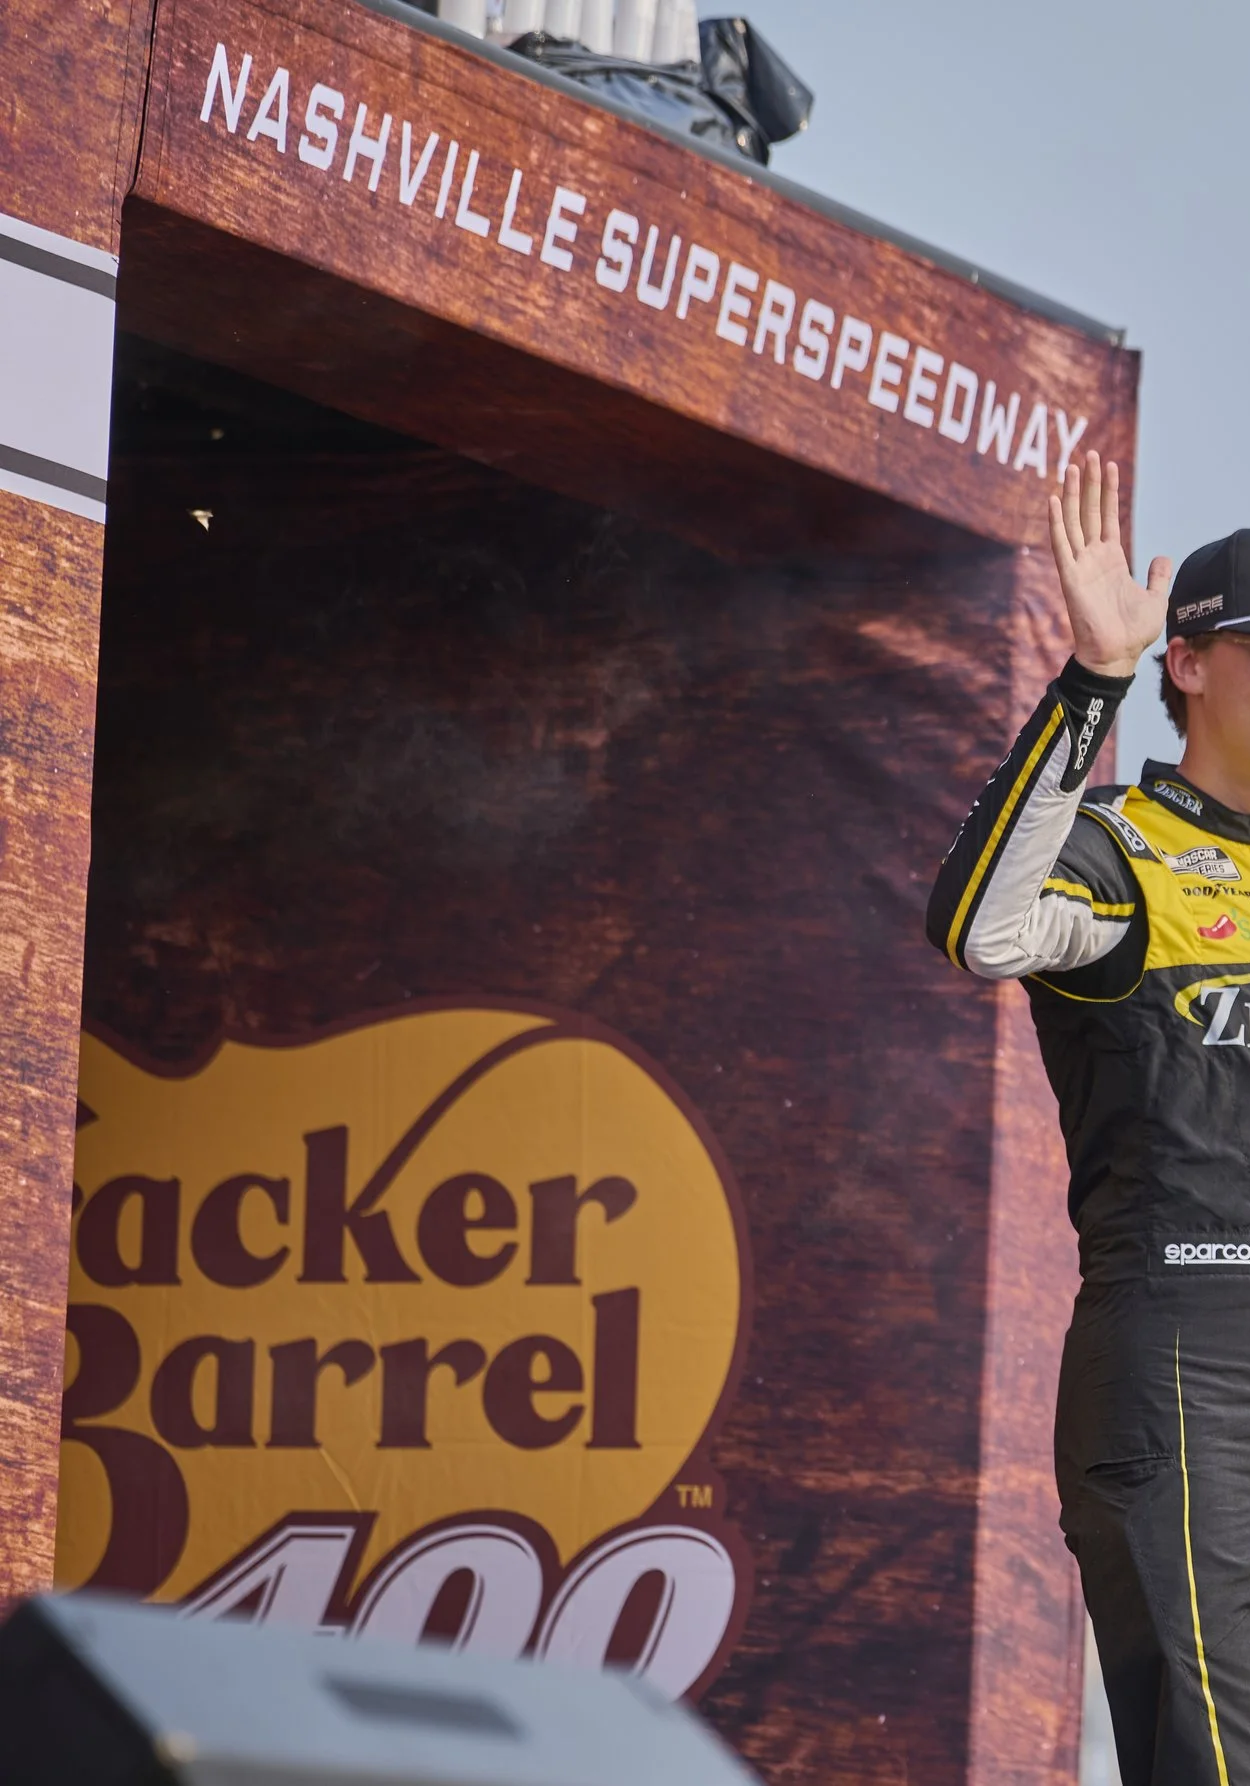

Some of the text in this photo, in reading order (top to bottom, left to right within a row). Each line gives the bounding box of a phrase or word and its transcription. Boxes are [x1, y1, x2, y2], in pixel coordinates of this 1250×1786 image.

[200, 42, 1088, 483] NASHVILLE SUPERSPEEDWAY
[1074, 697, 1104, 770] sparco
[1154, 783, 1204, 816] ZEIGLER
[1193, 864, 1226, 876] ERIES
